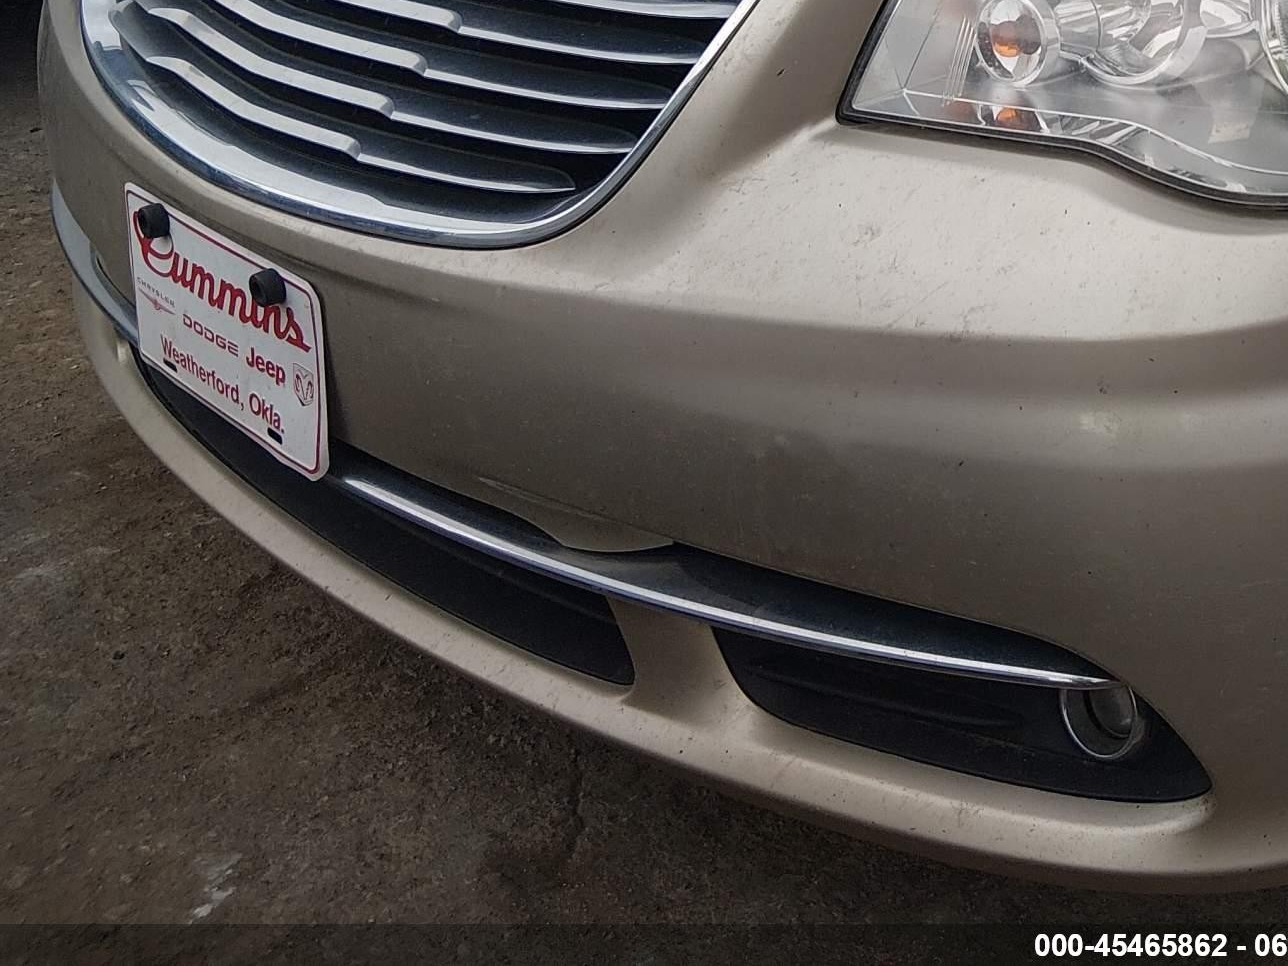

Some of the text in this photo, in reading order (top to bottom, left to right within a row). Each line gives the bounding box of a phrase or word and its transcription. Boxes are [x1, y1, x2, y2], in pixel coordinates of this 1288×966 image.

[182, 313, 239, 358] DODGE
[160, 334, 286, 434] Weatherford, Okla.
[245, 347, 286, 388] Jeep
